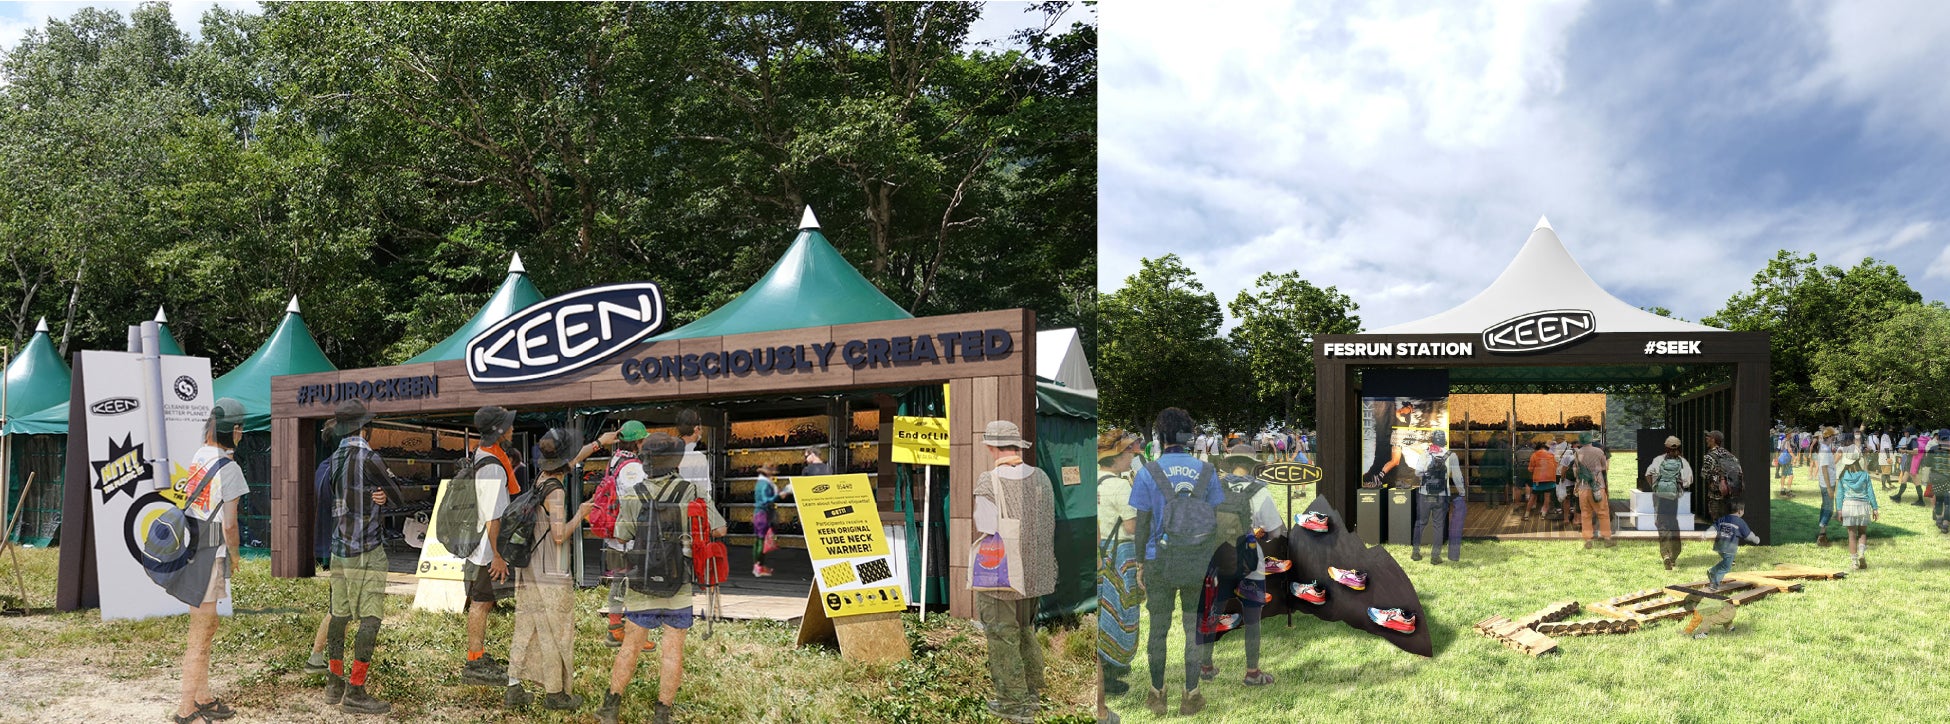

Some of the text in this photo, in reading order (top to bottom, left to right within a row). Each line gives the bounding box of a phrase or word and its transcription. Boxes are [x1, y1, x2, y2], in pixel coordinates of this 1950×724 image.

[474, 294, 653, 372] KEEN
[1489, 316, 1589, 346] KEEN
[621, 328, 1013, 382] CONSCIOUSLY CREATED
[1324, 342, 1473, 356] FESRUN STATION
[1644, 341, 1701, 355] #SEEK
[297, 375, 439, 404] #FUJIROCKEEN
[92, 400, 138, 413] KEEN
[898, 430, 949, 441] End of LIN
[1163, 465, 1200, 480] JIROCK
[1259, 465, 1320, 482] KEEN
[817, 525, 871, 536] KEEN ORIGINAL
[820, 533, 874, 546] TUBE NECK
[826, 543, 873, 556] WARMER!
